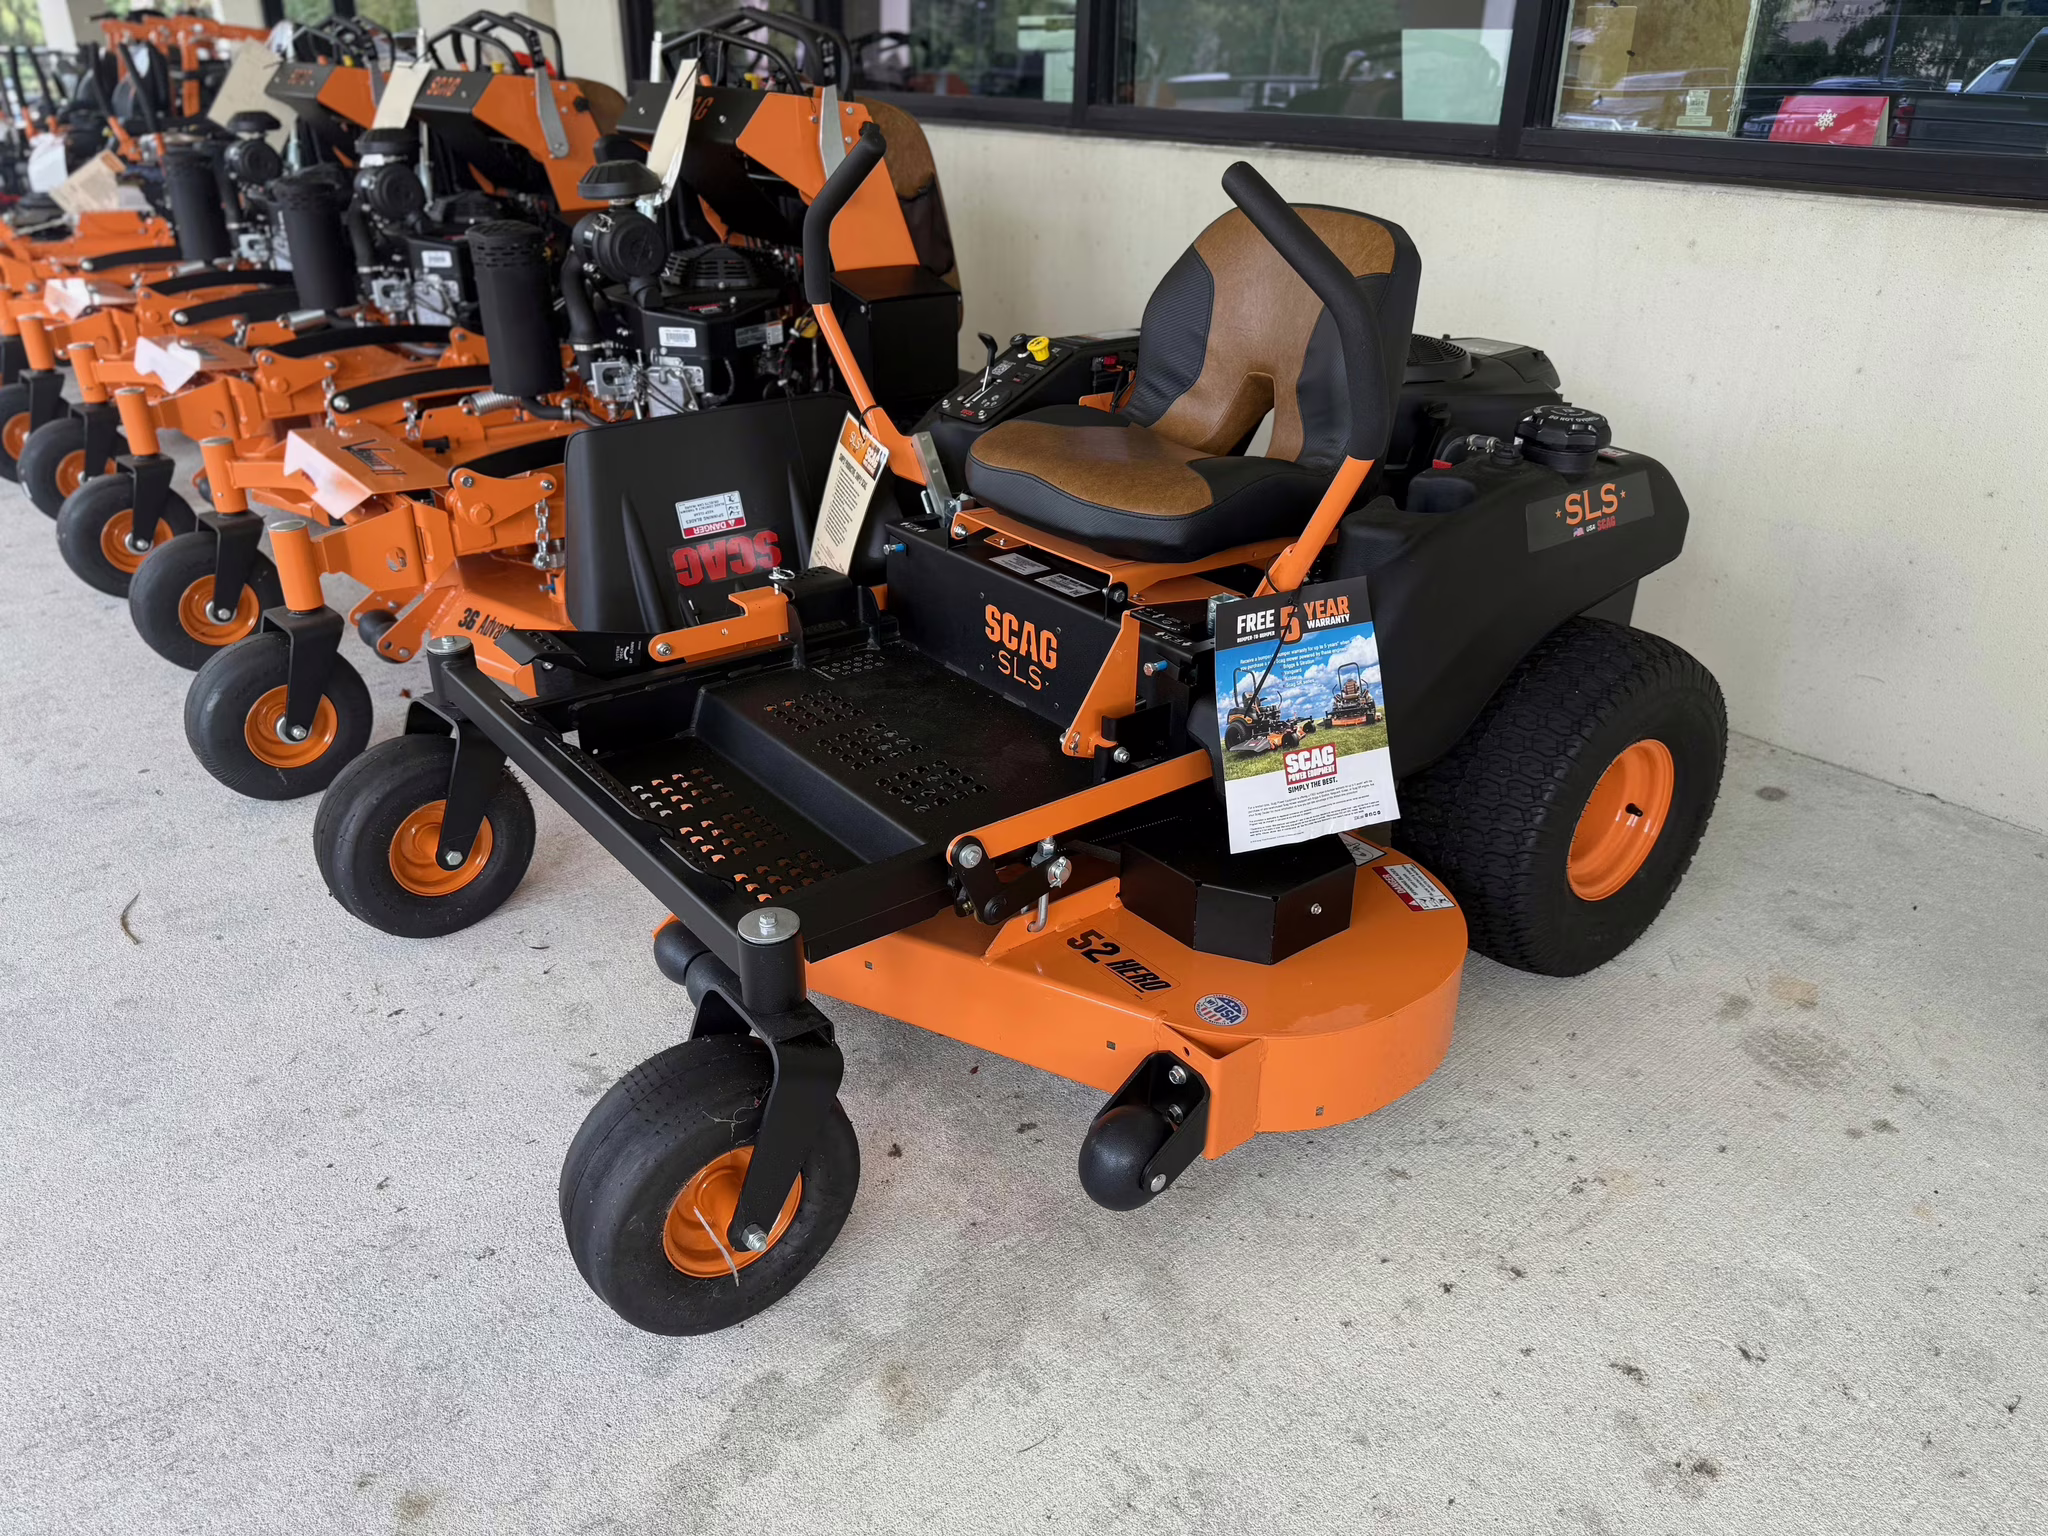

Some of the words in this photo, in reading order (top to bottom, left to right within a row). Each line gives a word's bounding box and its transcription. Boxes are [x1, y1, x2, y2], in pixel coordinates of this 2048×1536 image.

[1565, 483, 1618, 525] SLS
[693, 520, 726, 534] DANGER
[1597, 516, 1616, 531] SCAG
[672, 530, 782, 587] SCAG
[458, 608, 480, 630] 36
[1236, 609, 1275, 634] FREE
[1280, 606, 1300, 642] 5
[1304, 596, 1350, 620] YEAR
[1306, 614, 1350, 629] WARRANTY
[985, 604, 1057, 670] SCAG
[1236, 631, 1275, 644] BUMPER-TO-BUMPER
[998, 650, 1041, 691] SLS
[1285, 746, 1335, 774] SCAG
[1288, 771, 1307, 782] POWER
[1308, 766, 1335, 778] EQUIPMENT
[1288, 781, 1310, 794] SIMPLY
[1310, 780, 1322, 788] THE
[1322, 777, 1338, 785] BEST.
[1382, 874, 1406, 893] DANGER
[1066, 928, 1121, 964] 52
[1104, 958, 1171, 991] HERO
[1214, 1004, 1241, 1023] USA
